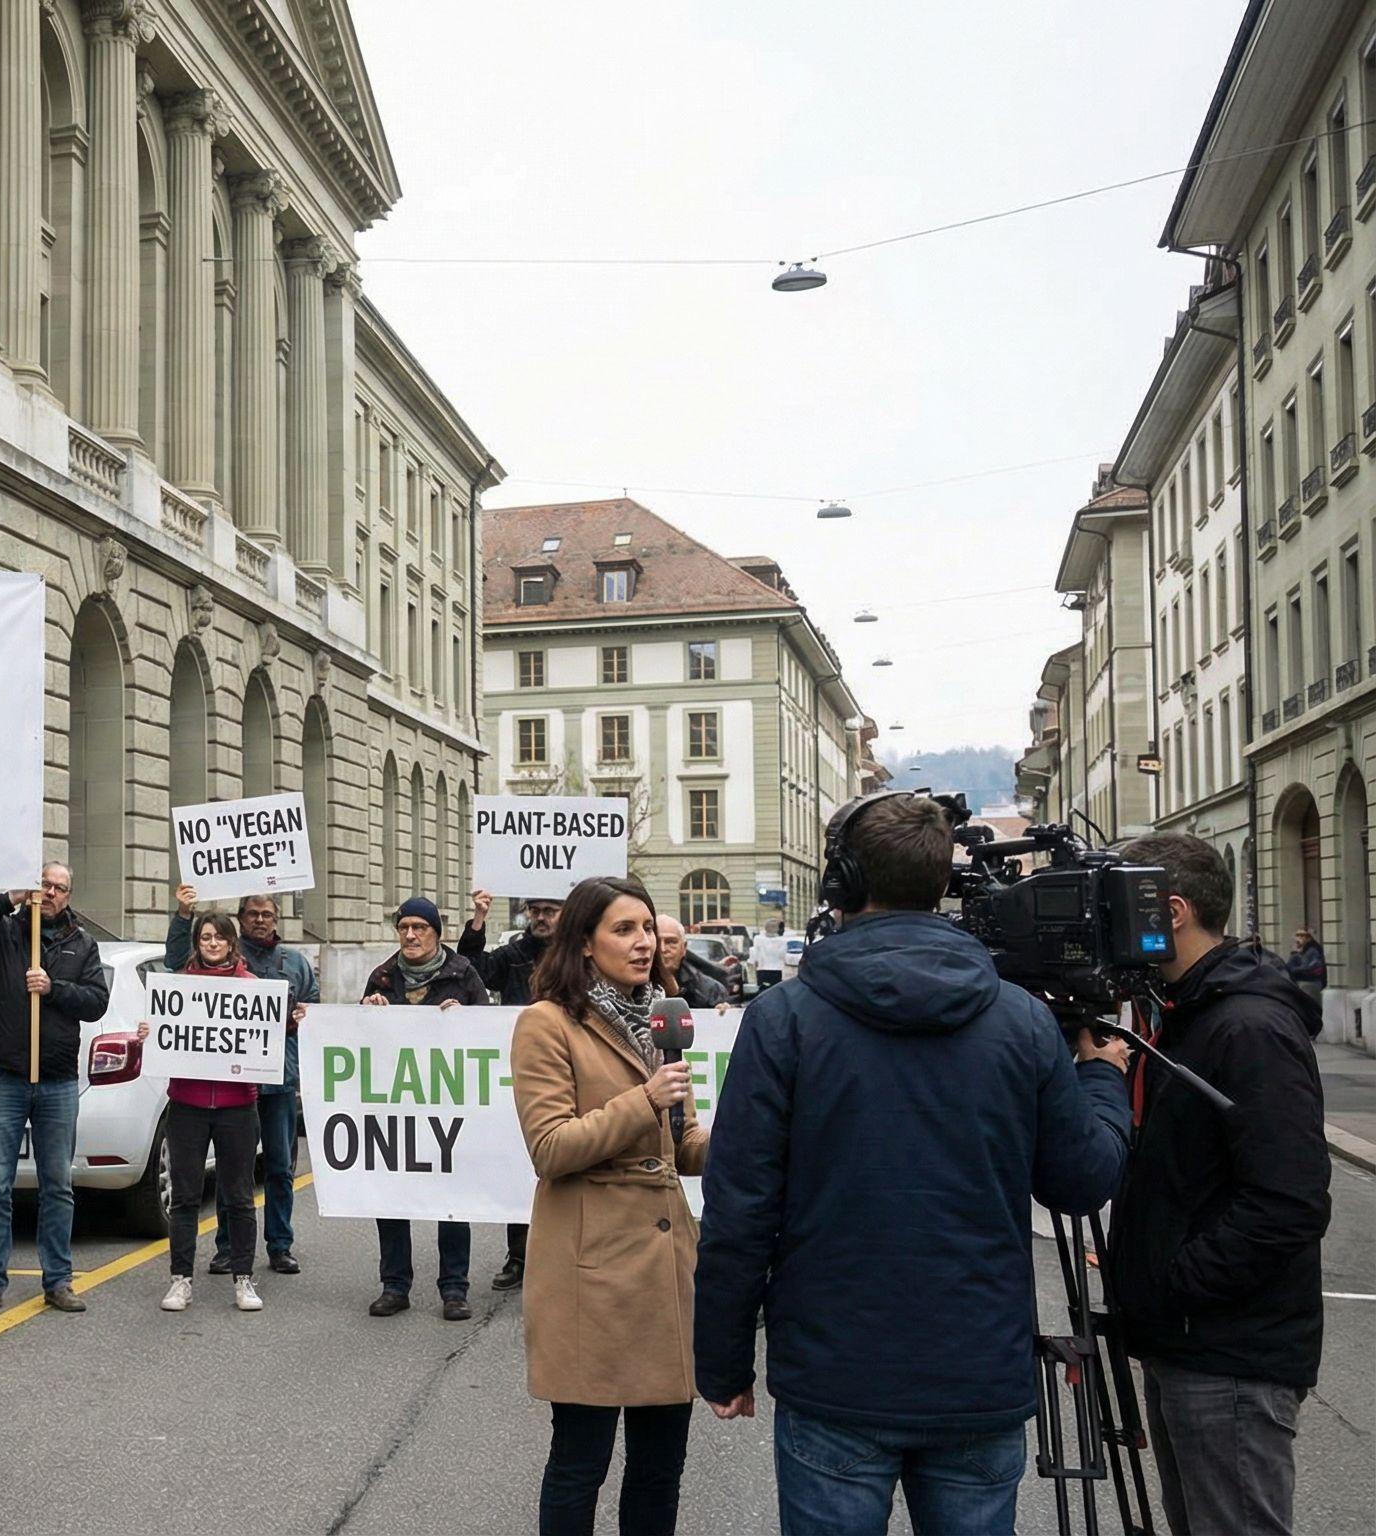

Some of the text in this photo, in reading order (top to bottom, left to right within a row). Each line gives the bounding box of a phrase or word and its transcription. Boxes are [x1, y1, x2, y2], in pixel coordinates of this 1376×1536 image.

[178, 806, 303, 844] NO “VEGAN
[477, 810, 625, 838] PLANT-BASED
[192, 840, 295, 876] CHEESE”!
[520, 843, 577, 870] ONLY
[150, 988, 281, 1023] NO “VEGAN
[157, 1023, 269, 1056] CHEESE”!
[323, 1113, 464, 1174] ONLY
